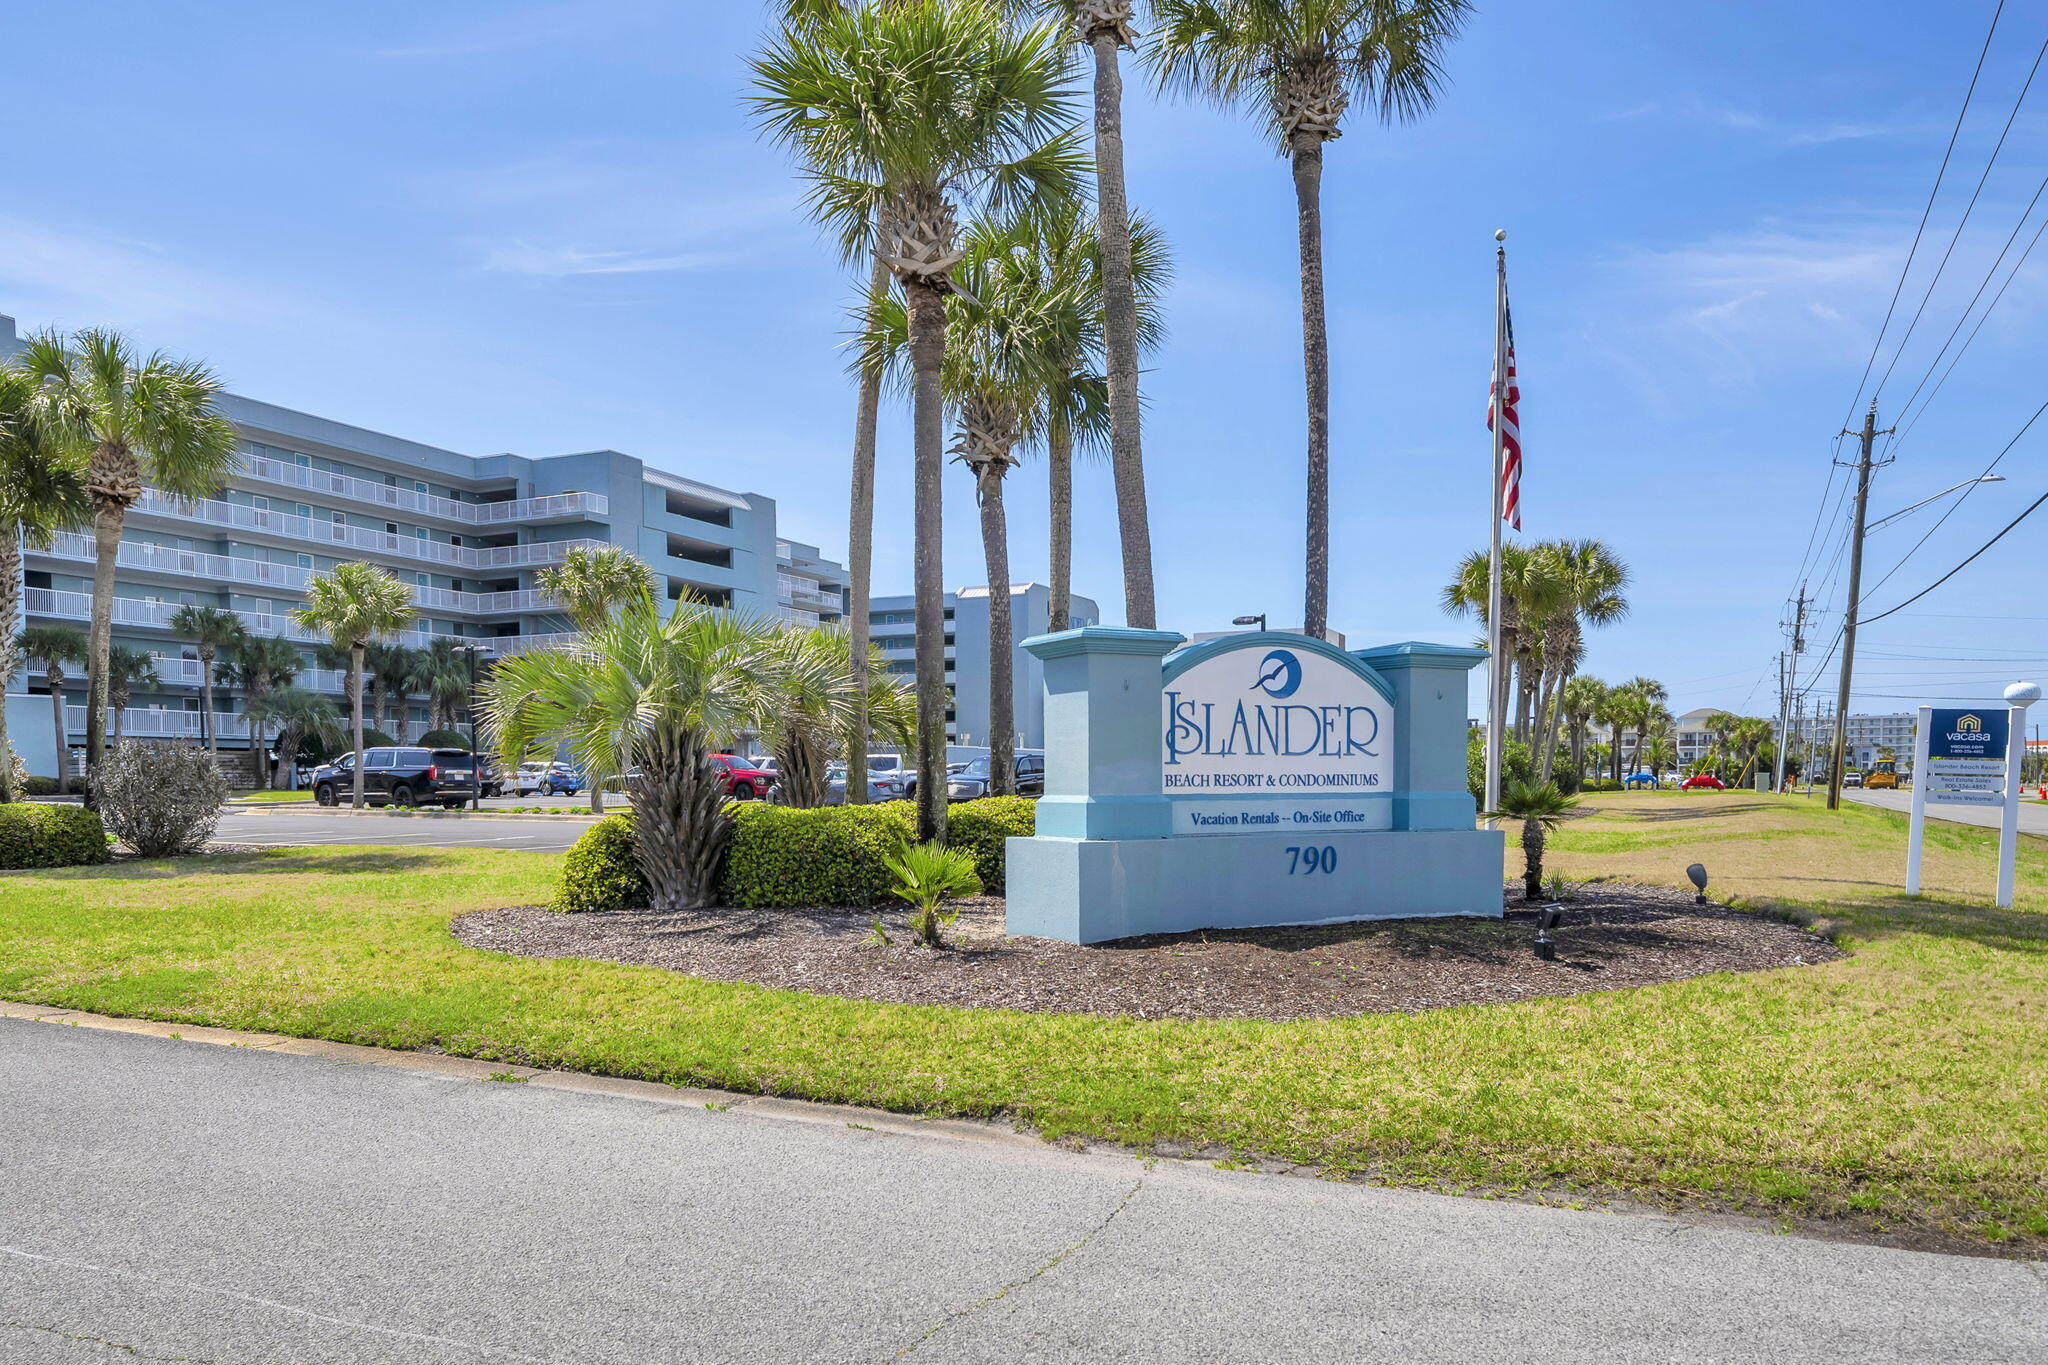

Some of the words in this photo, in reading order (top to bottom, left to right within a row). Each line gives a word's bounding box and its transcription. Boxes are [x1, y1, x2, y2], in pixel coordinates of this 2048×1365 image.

[1946, 732, 1991, 742] vacasa
[1164, 774, 1210, 788] BEACH
[1213, 774, 1264, 787] RESORT
[1266, 775, 1276, 787] &
[1279, 773, 1379, 787] CONDOMINIUMS
[1191, 812, 1238, 826] Vacation
[1242, 812, 1279, 825] Rentals
[1293, 811, 1332, 824] On-Site
[1334, 810, 1365, 823] Office
[1285, 846, 1338, 875] 790
